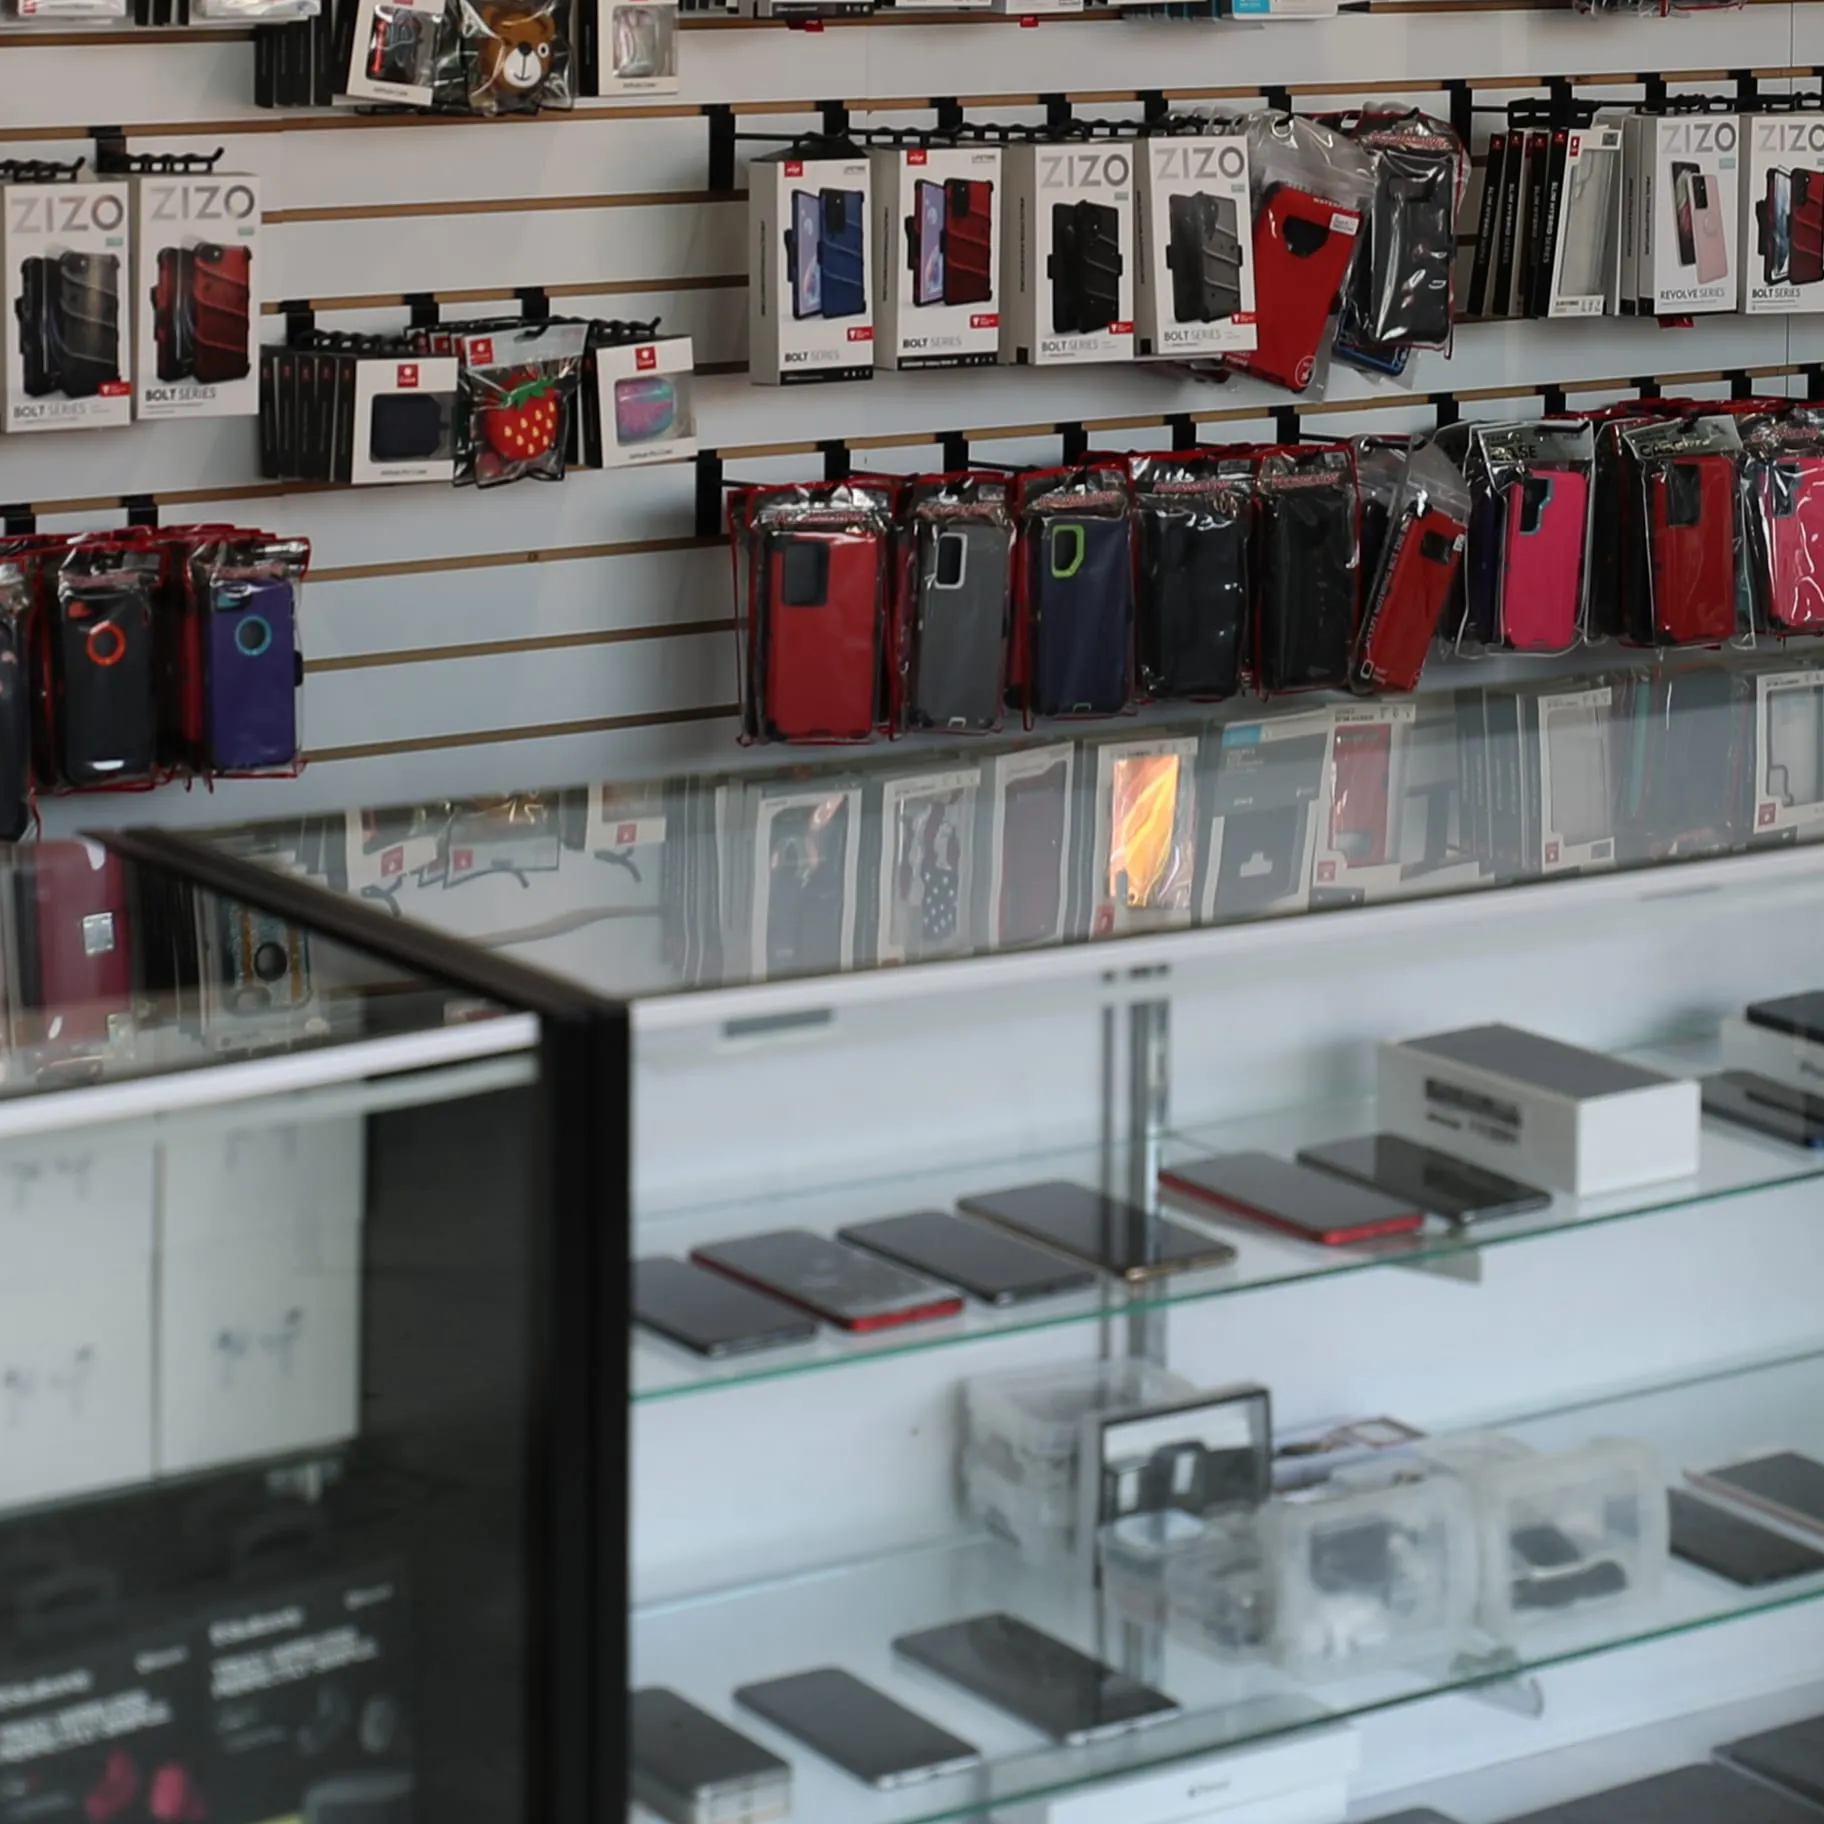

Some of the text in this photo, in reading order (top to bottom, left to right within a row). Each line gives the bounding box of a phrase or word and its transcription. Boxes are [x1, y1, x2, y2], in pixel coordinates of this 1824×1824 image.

[1662, 122, 1736, 153] ZIZO
[1156, 145, 1244, 179] ZIZO
[1040, 154, 1129, 188] ZIZO
[152, 184, 255, 221] ZIZO
[12, 194, 124, 235] ZIZO
[1660, 288, 1725, 300] REVOLVE SERIES
[1752, 288, 1801, 299] BOLT SERIES
[1163, 330, 1188, 341] BOLT
[902, 337, 928, 349] BOLT
[1042, 341, 1067, 352] BOLT
[784, 351, 809, 363] BOLT
[145, 387, 216, 402] BOLT SERIES
[14, 404, 45, 418] BOLT
